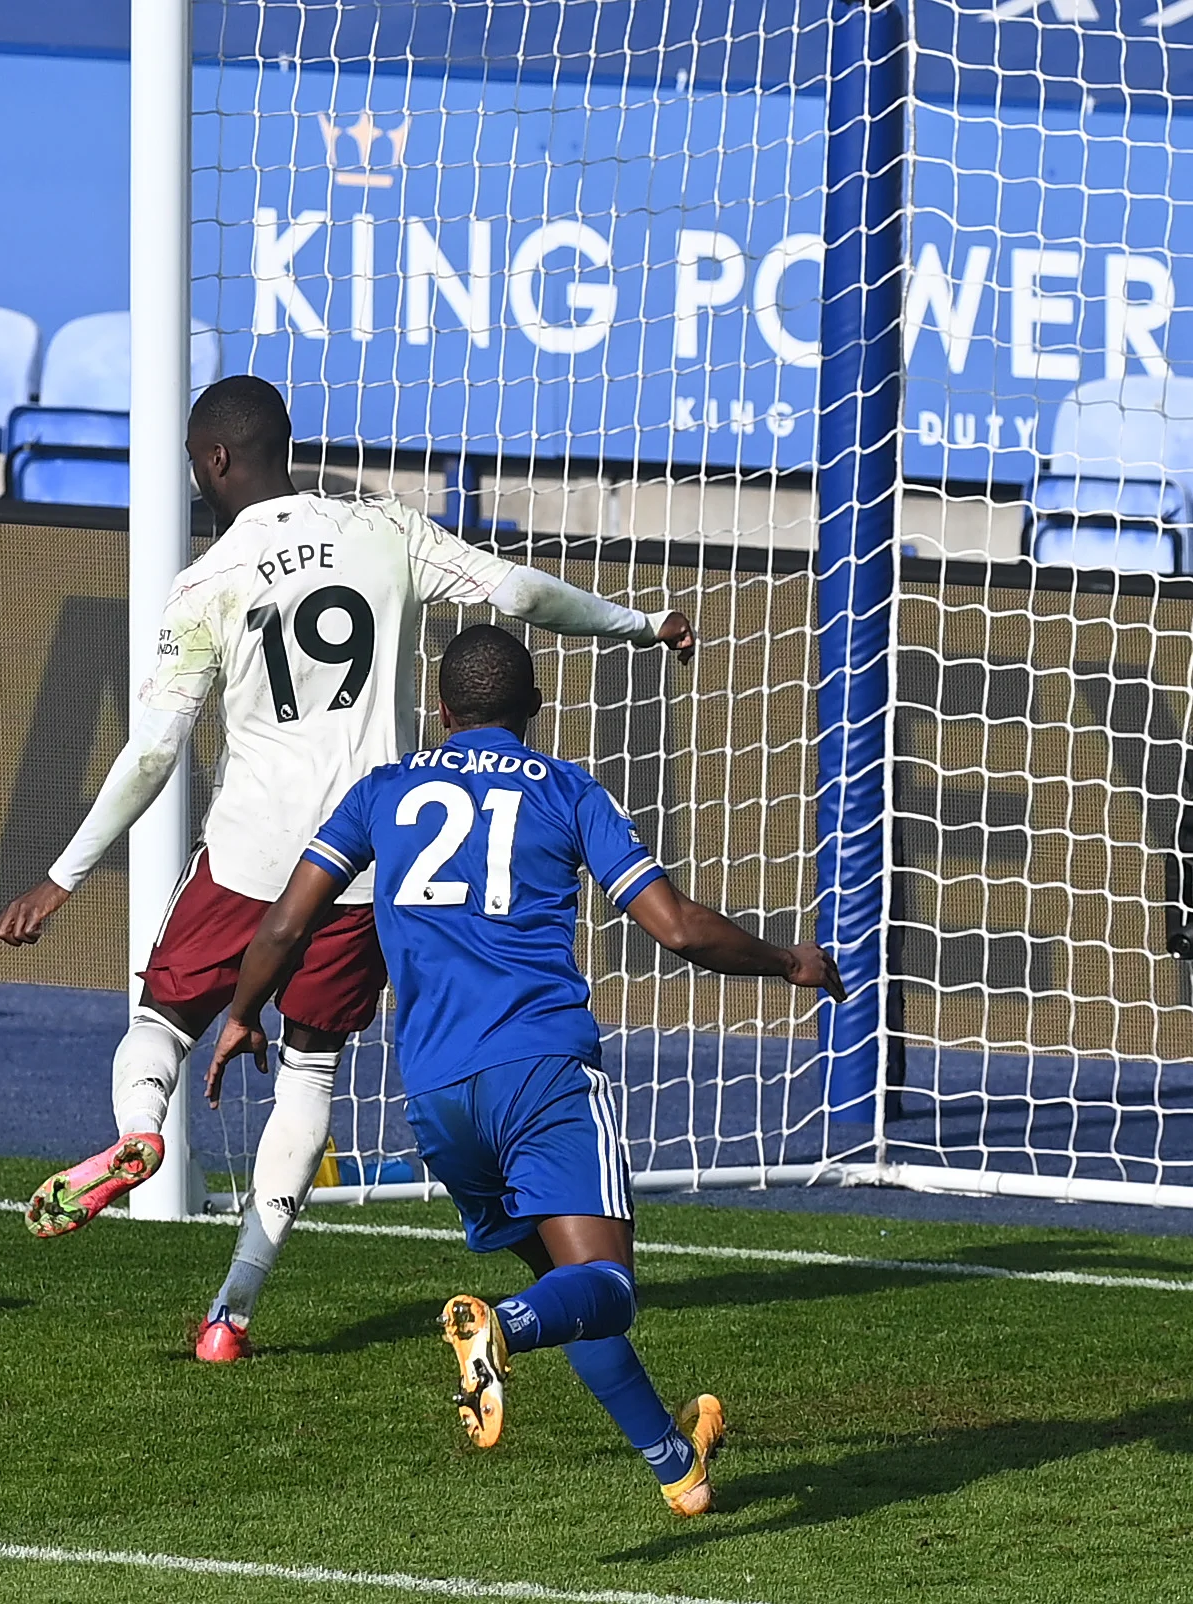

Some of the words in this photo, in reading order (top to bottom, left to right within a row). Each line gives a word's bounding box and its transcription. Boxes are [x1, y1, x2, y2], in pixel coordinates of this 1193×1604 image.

[253, 206, 619, 354] KING
[676, 396, 796, 437] KING
[918, 410, 1035, 449] DUTY
[257, 543, 334, 585] PEPE
[247, 585, 375, 723] 19
[409, 749, 547, 781] RICARDO
[393, 780, 523, 915] 21
